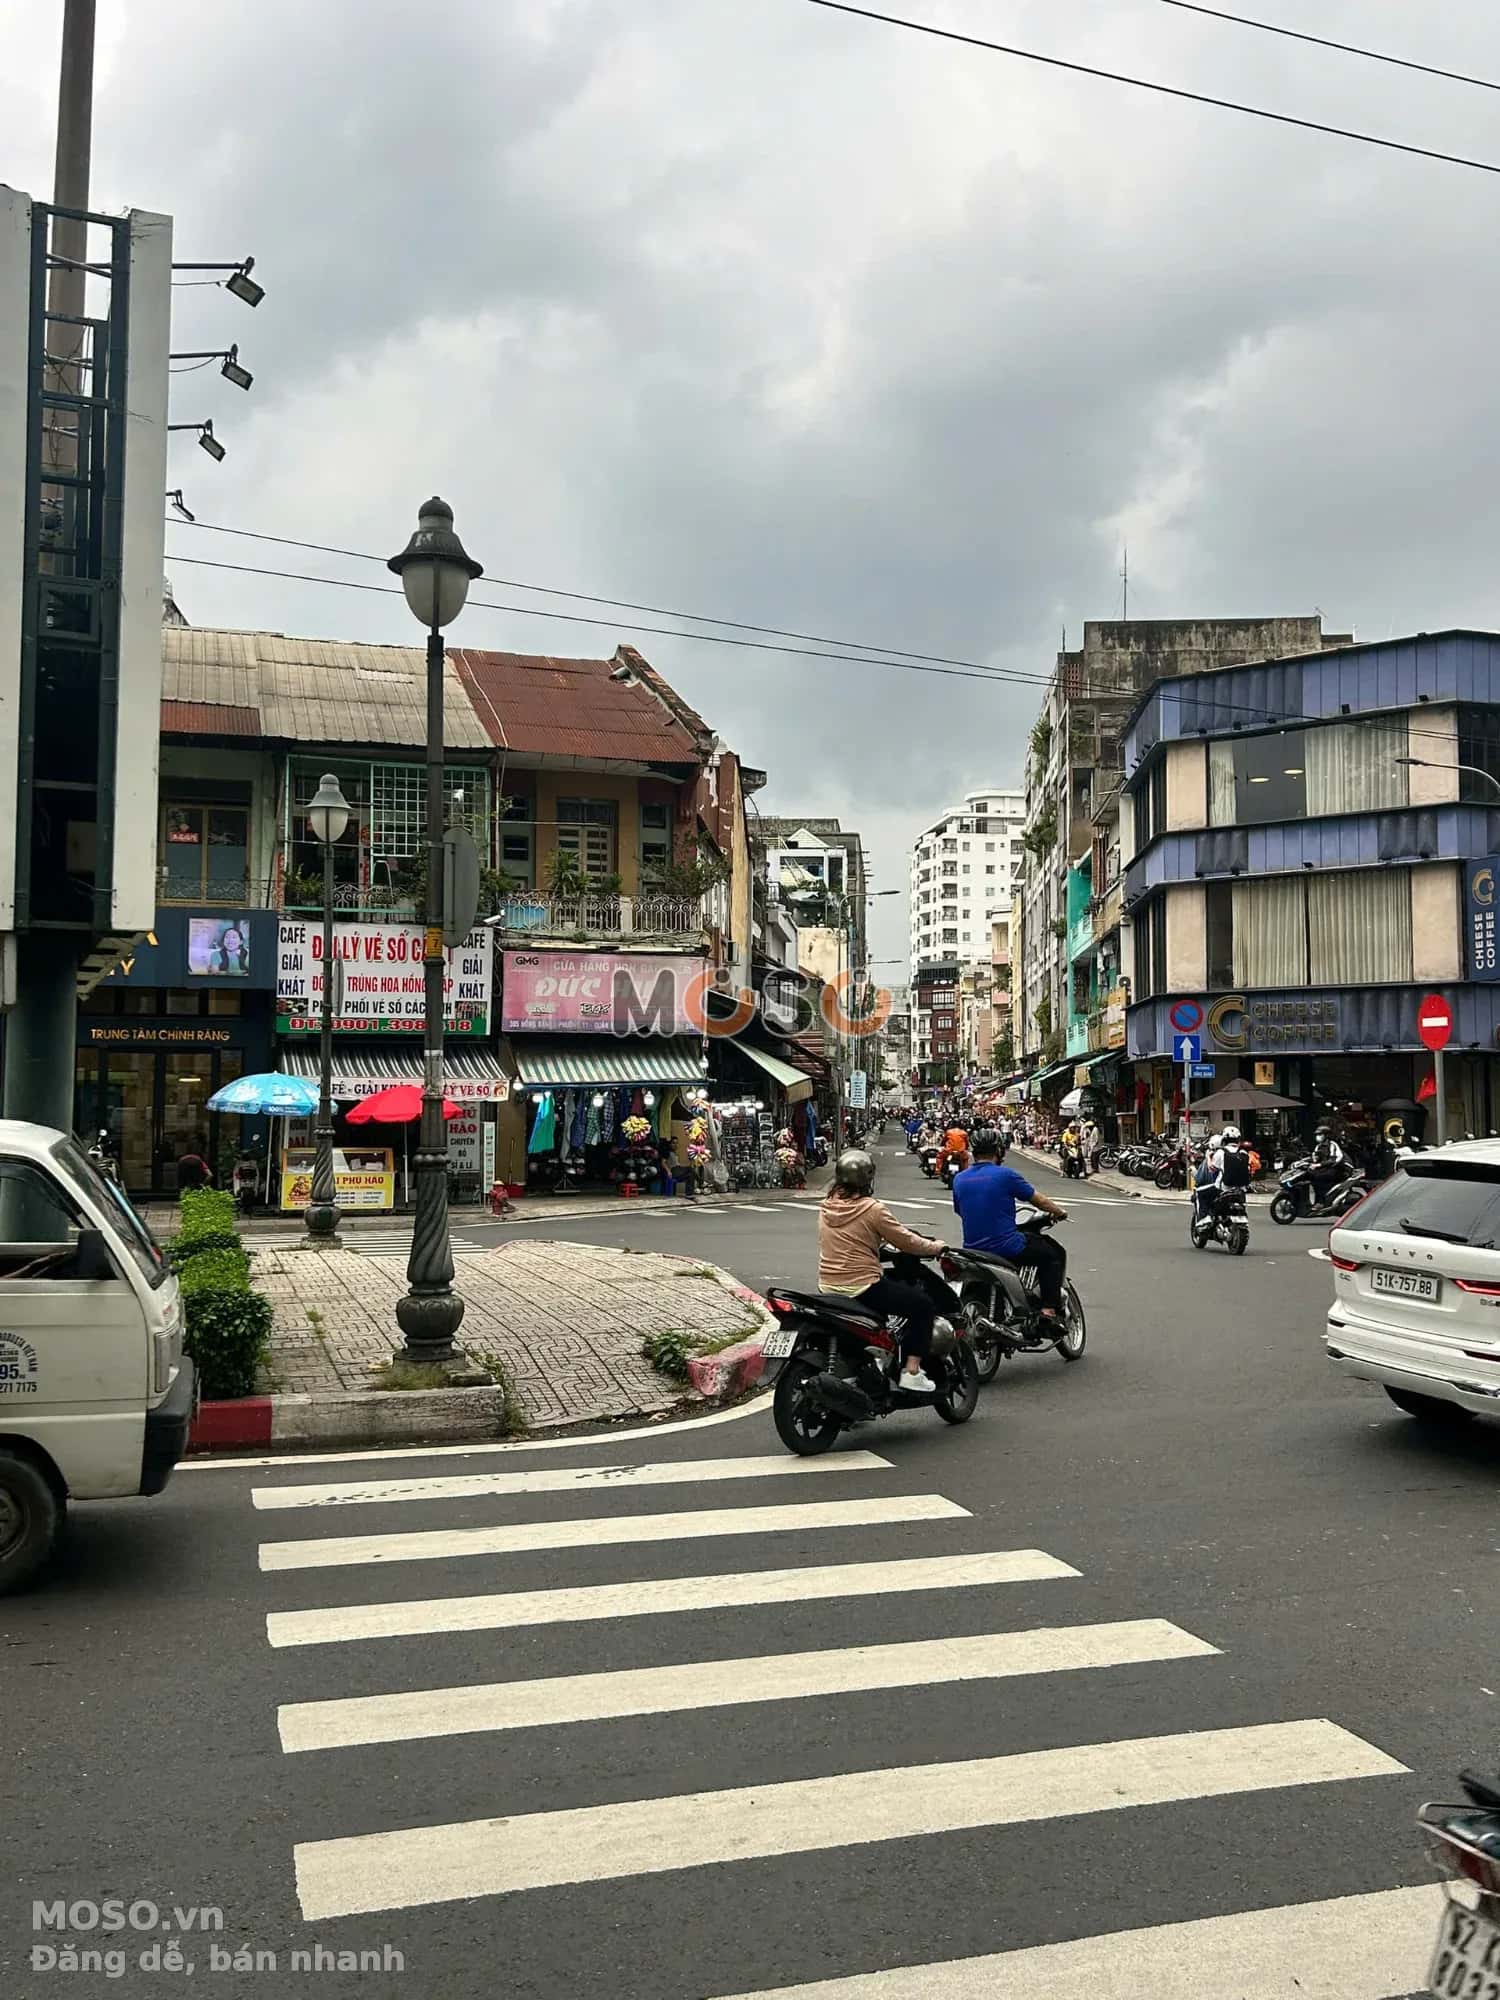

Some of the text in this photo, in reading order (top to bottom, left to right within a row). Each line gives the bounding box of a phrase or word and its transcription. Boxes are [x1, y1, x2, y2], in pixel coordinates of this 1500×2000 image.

[280, 923, 306, 944] CAFÉ
[1475, 912, 1485, 970] CHEESE
[1486, 911, 1496, 969] COFFEE
[281, 948, 303, 971] GIẢI
[463, 953, 483, 975] GIẢI
[515, 956, 540, 966] GMG
[278, 975, 306, 996] KHÁT
[381, 976, 400, 993] HOA
[459, 979, 485, 999] KHÁT
[1254, 1001, 1336, 1018] CHEESE
[91, 1029, 129, 1040] TRUNG
[1254, 1024, 1336, 1041] COFFEE
[1376, 1272, 1433, 1296] 51K-757.88
[16, 1381, 37, 1393] 7175
